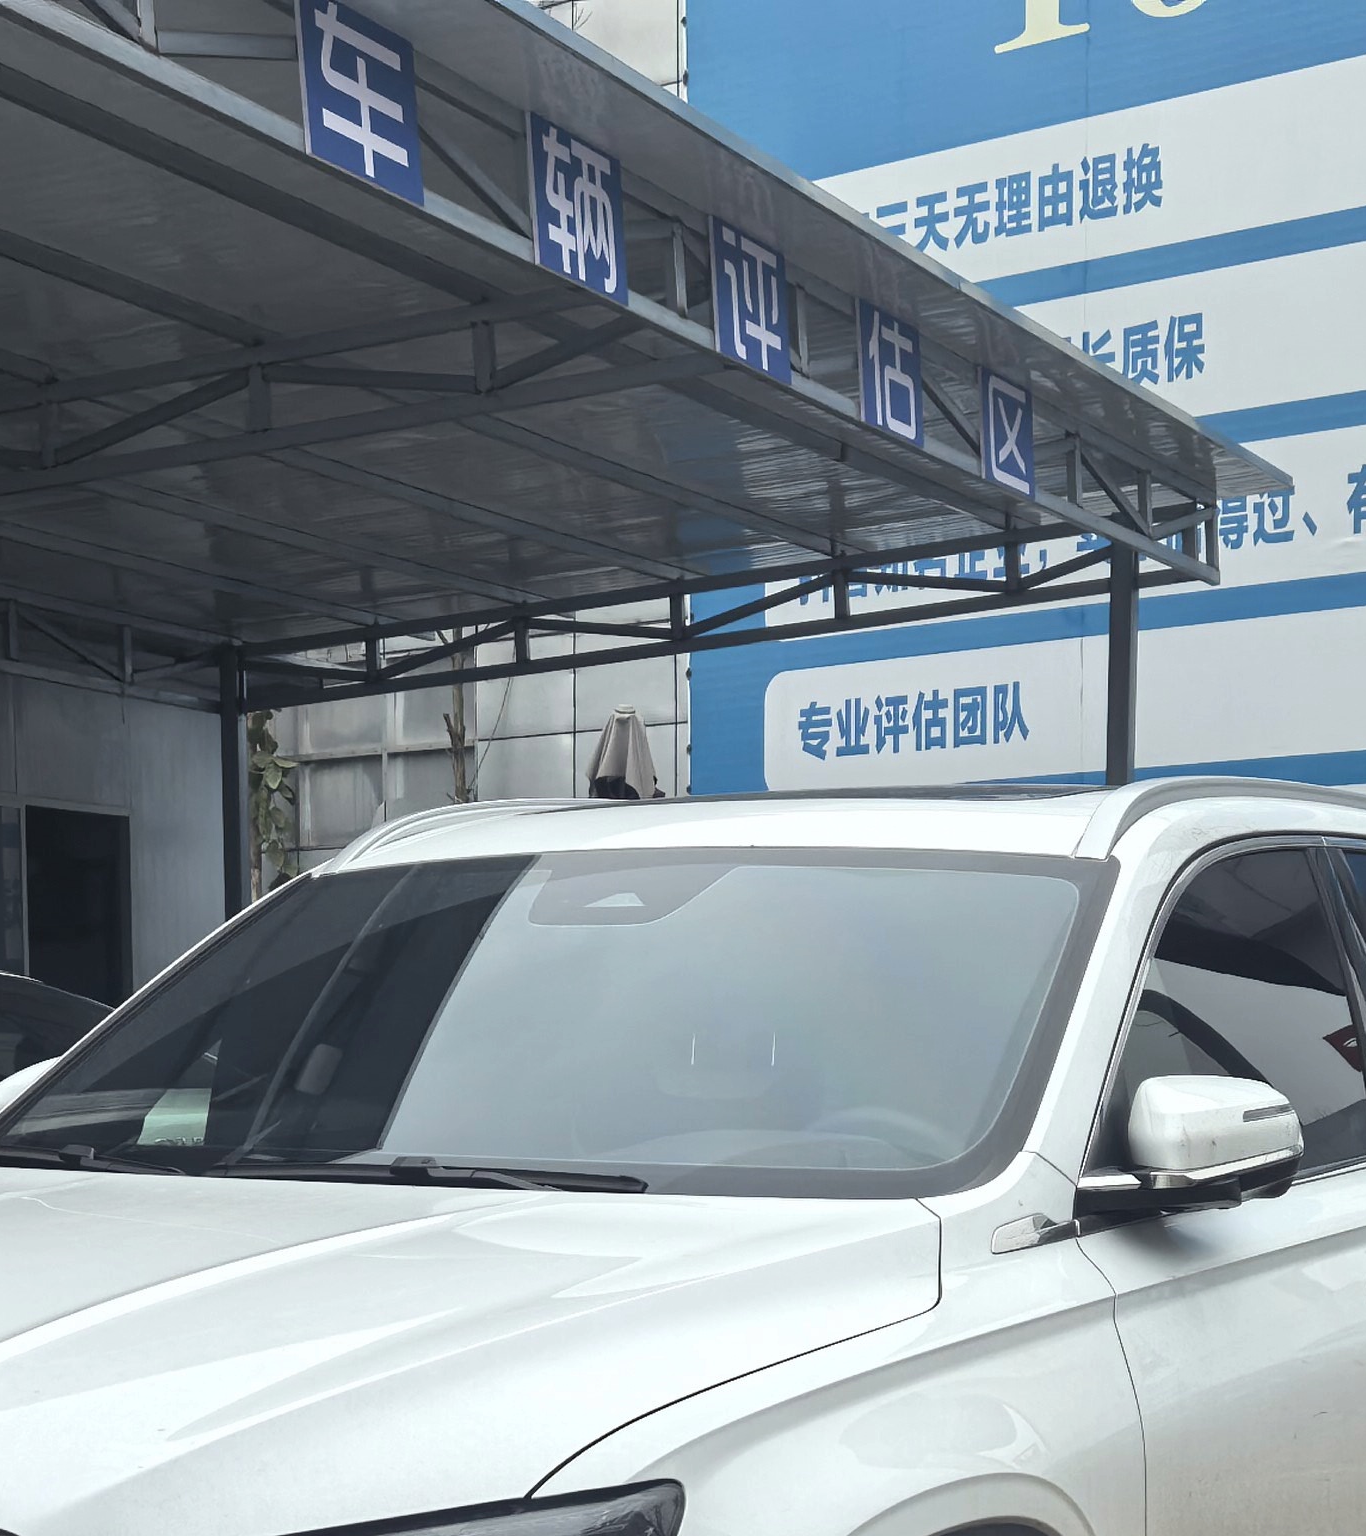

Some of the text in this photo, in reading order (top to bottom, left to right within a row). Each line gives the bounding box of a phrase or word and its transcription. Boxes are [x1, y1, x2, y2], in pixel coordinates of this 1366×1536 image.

[863, 143, 1164, 253] 三天无理由退换
[797, 680, 1030, 761] 专业评估团队
